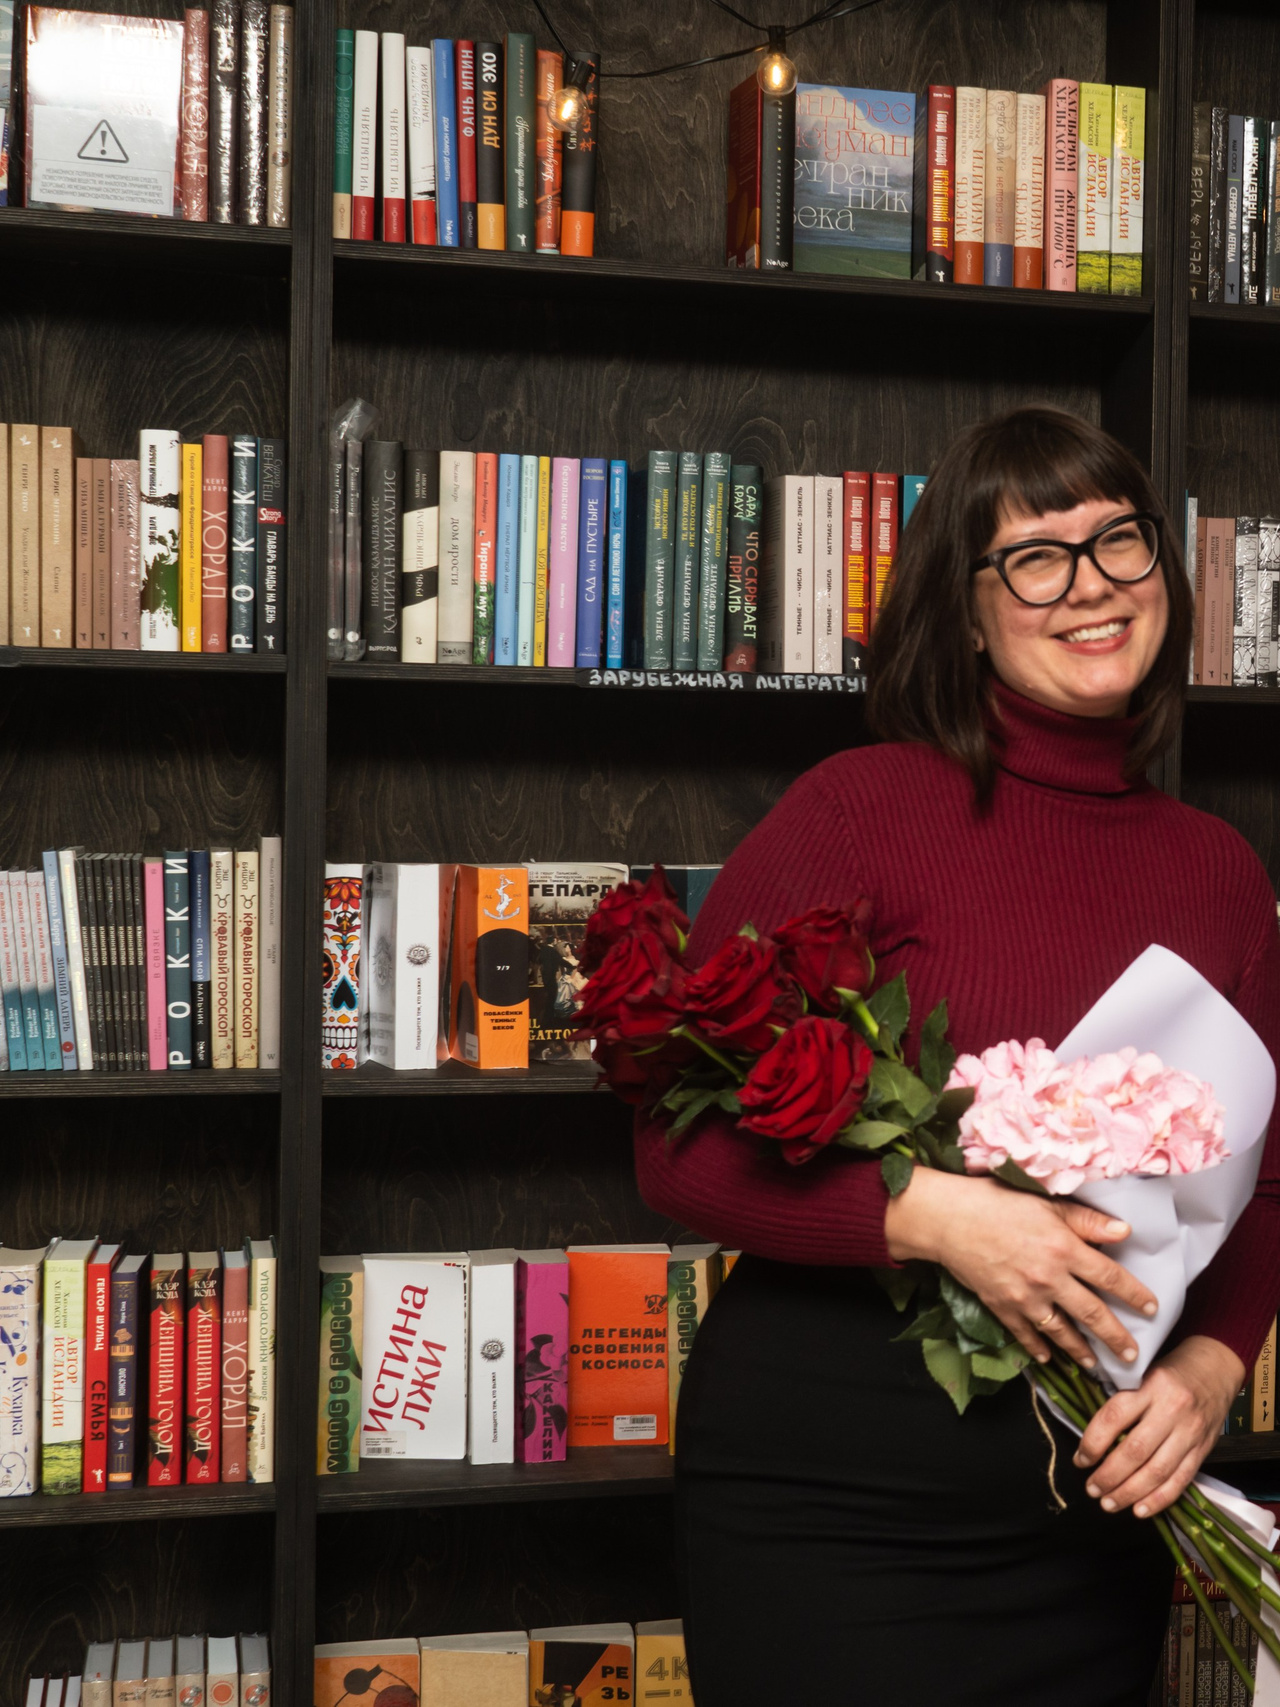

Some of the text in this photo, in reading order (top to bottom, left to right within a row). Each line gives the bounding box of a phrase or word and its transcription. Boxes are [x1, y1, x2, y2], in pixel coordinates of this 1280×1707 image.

[421, 63, 430, 123] ТАНИДЗАКИ
[461, 49, 475, 137] ФАНЬ ИПИН
[482, 52, 500, 148] ДУН СИ ЭХО
[844, 187, 909, 213] ник
[956, 176, 968, 236] МЕСТЬ
[972, 149, 984, 237] АКИМИТИ
[1085, 153, 1097, 237] ИСЛАНДИИ
[1097, 154, 1108, 198] АВТОР
[1247, 137, 1259, 219] ПАВЕЛ ЧЖАН
[794, 206, 855, 232] ека
[1227, 187, 1238, 262] СЕРЕБРЯНАЯ ЛЕГЕНДА
[263, 444, 274, 502] ВЕНКАТЕШ
[734, 485, 744, 518] КРАУЧ
[745, 485, 757, 518] САРА
[202, 510, 227, 598] ХОРАЛ
[231, 441, 255, 649] РОККИ
[371, 496, 380, 607] НИКОС КАЗАНДЗАКИС
[383, 470, 398, 634] КАПИТАН МИХАЛИС
[587, 498, 598, 553] ПУСТЫРЕ
[612, 533, 621, 549] НОЧЬ
[265, 531, 277, 624] ГЛАВАРЬ БАНДЫ НА ДЕНЬ
[477, 541, 491, 618] Тирания мух
[585, 576, 596, 602] САД
[612, 550, 620, 576] ЛЕТНЮЮ
[612, 583, 620, 595] СОН
[656, 559, 665, 607] ФЕРРАНТЕ
[729, 555, 742, 613] ПРИЛИВ
[744, 532, 758, 639] ЧТО СКРЫВАЕТ
[589, 669, 743, 689] ЗАРУБЕЖНАЯ
[165, 858, 191, 1065] РОККИ
[218, 977, 228, 1038] ГОРОСКОП
[91, 1278, 106, 1441] СЕМЬЯ ГЕКТОР ШУЛЬЦ
[259, 1270, 270, 1401] Записки КНИГОТОРГОВЦА
[570, 1344, 665, 1354] ОСВОЕНИЯ
[582, 1328, 666, 1339] ЛЕГЕНДЫ
[222, 1340, 247, 1428] ХОРАЛ
[582, 1359, 665, 1370] КОСМОСА
[8, 1376, 28, 1436] Кухарка
